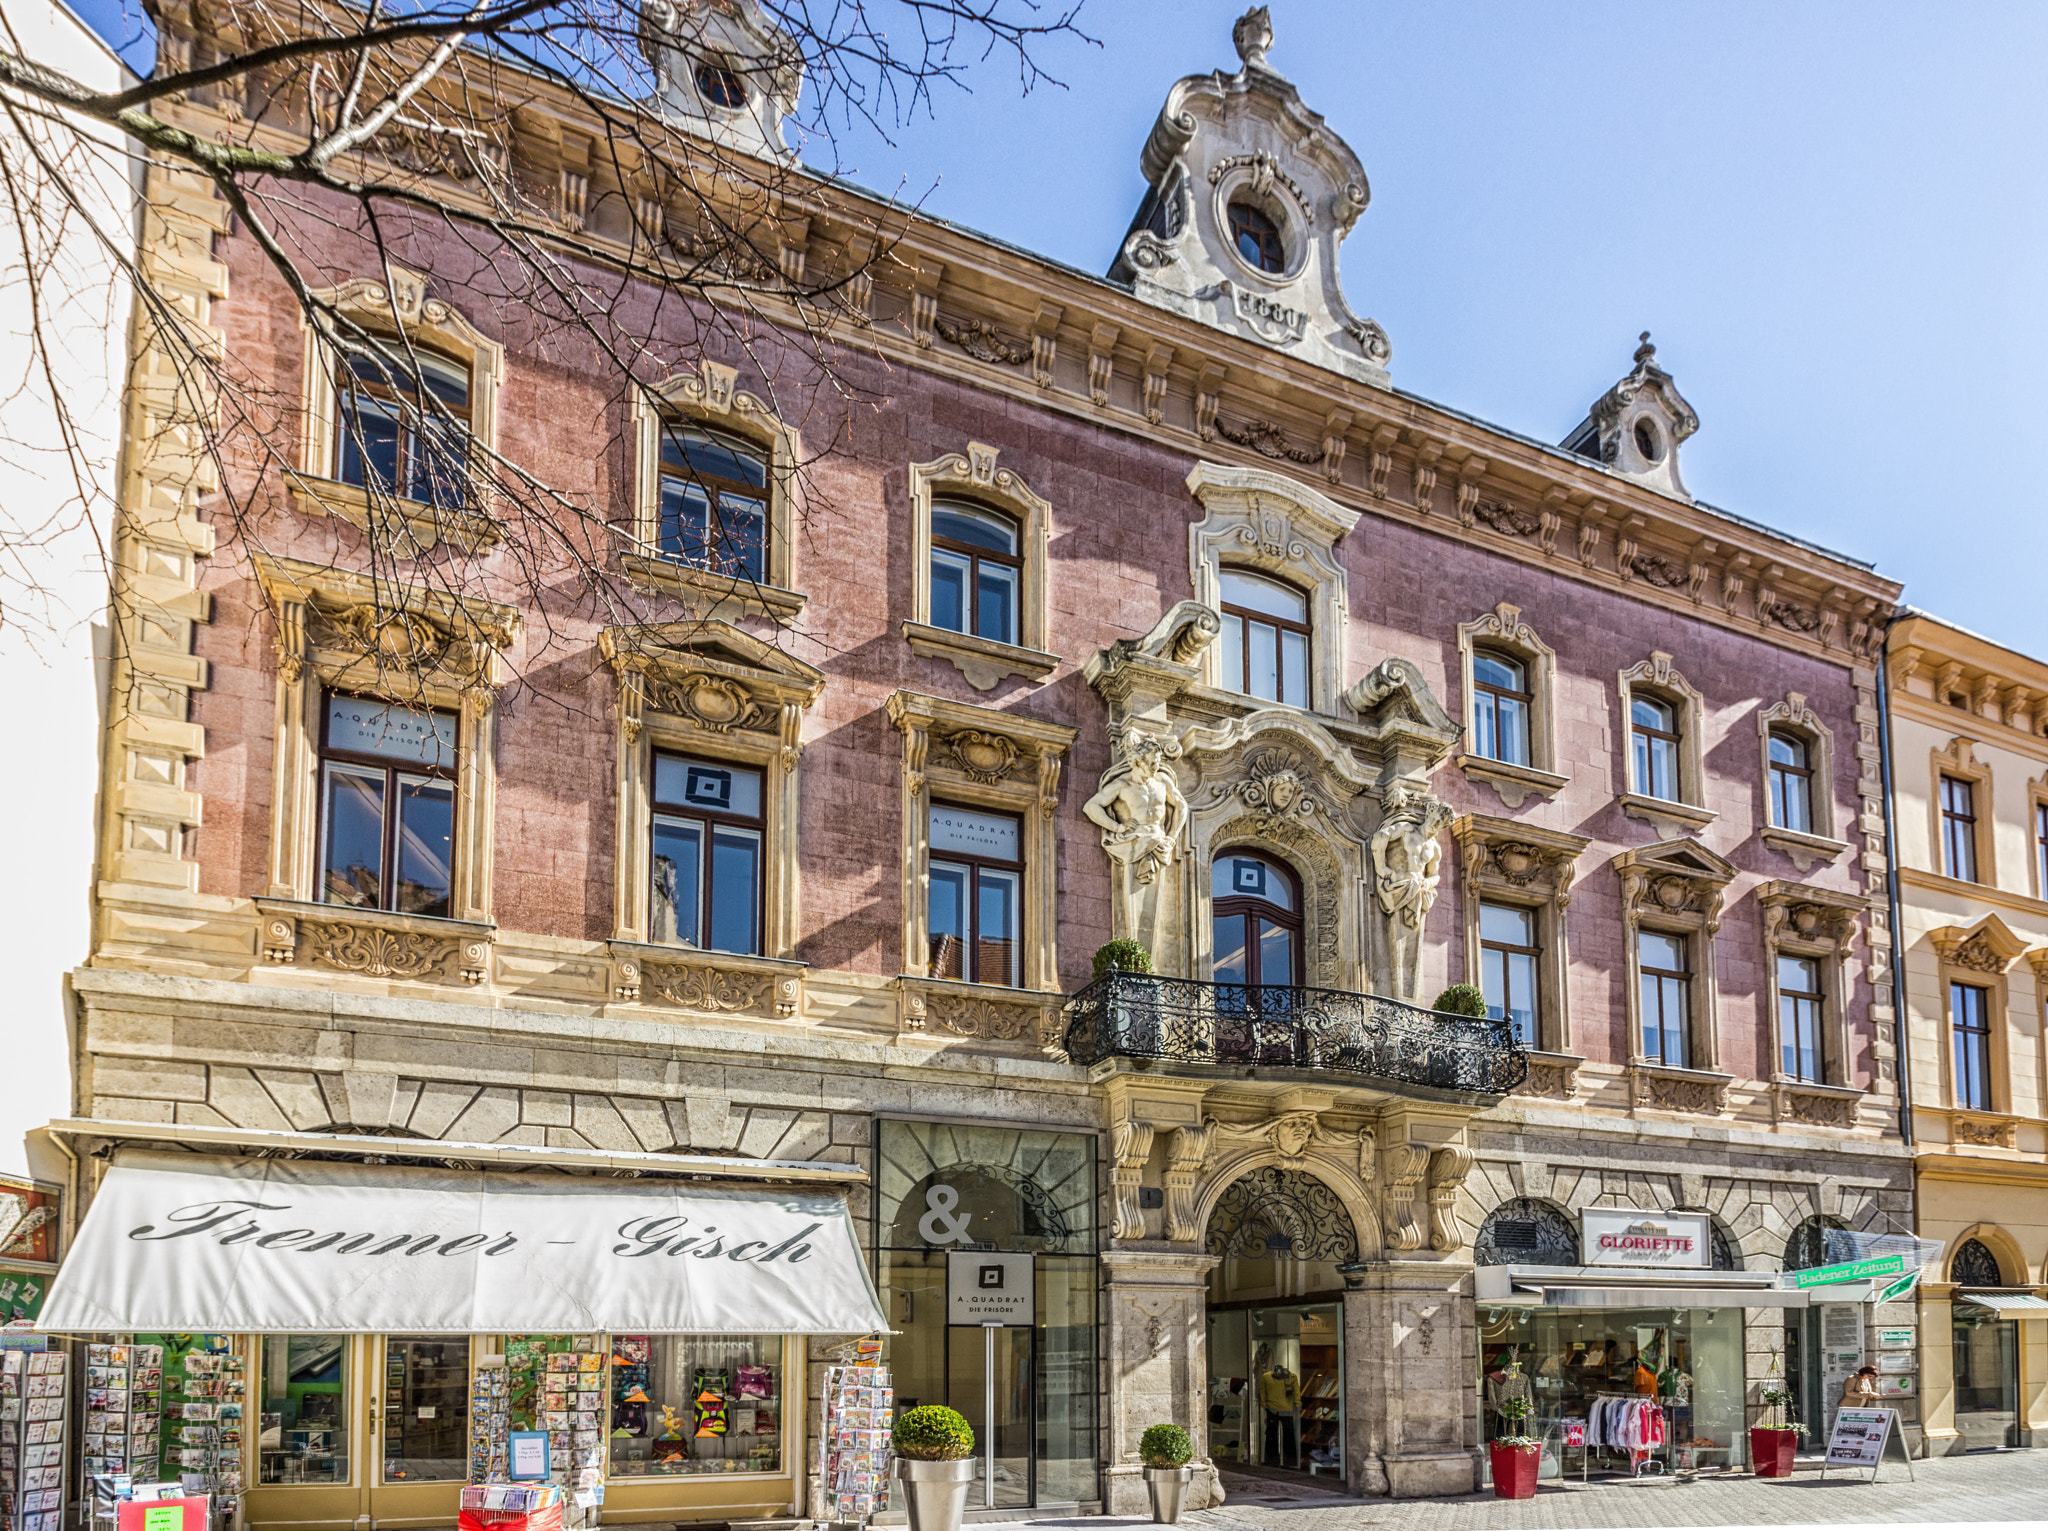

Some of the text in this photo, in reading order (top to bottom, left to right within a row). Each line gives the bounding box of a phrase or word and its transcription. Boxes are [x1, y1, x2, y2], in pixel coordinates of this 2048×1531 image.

[358, 730, 376, 739] DIE
[918, 1184, 975, 1245] &
[128, 1200, 519, 1256] Trenner
[612, 1215, 823, 1263] Gisch
[1600, 1235, 1695, 1252] GLORIETTE
[1798, 1260, 1902, 1285] Badener Zeitung
